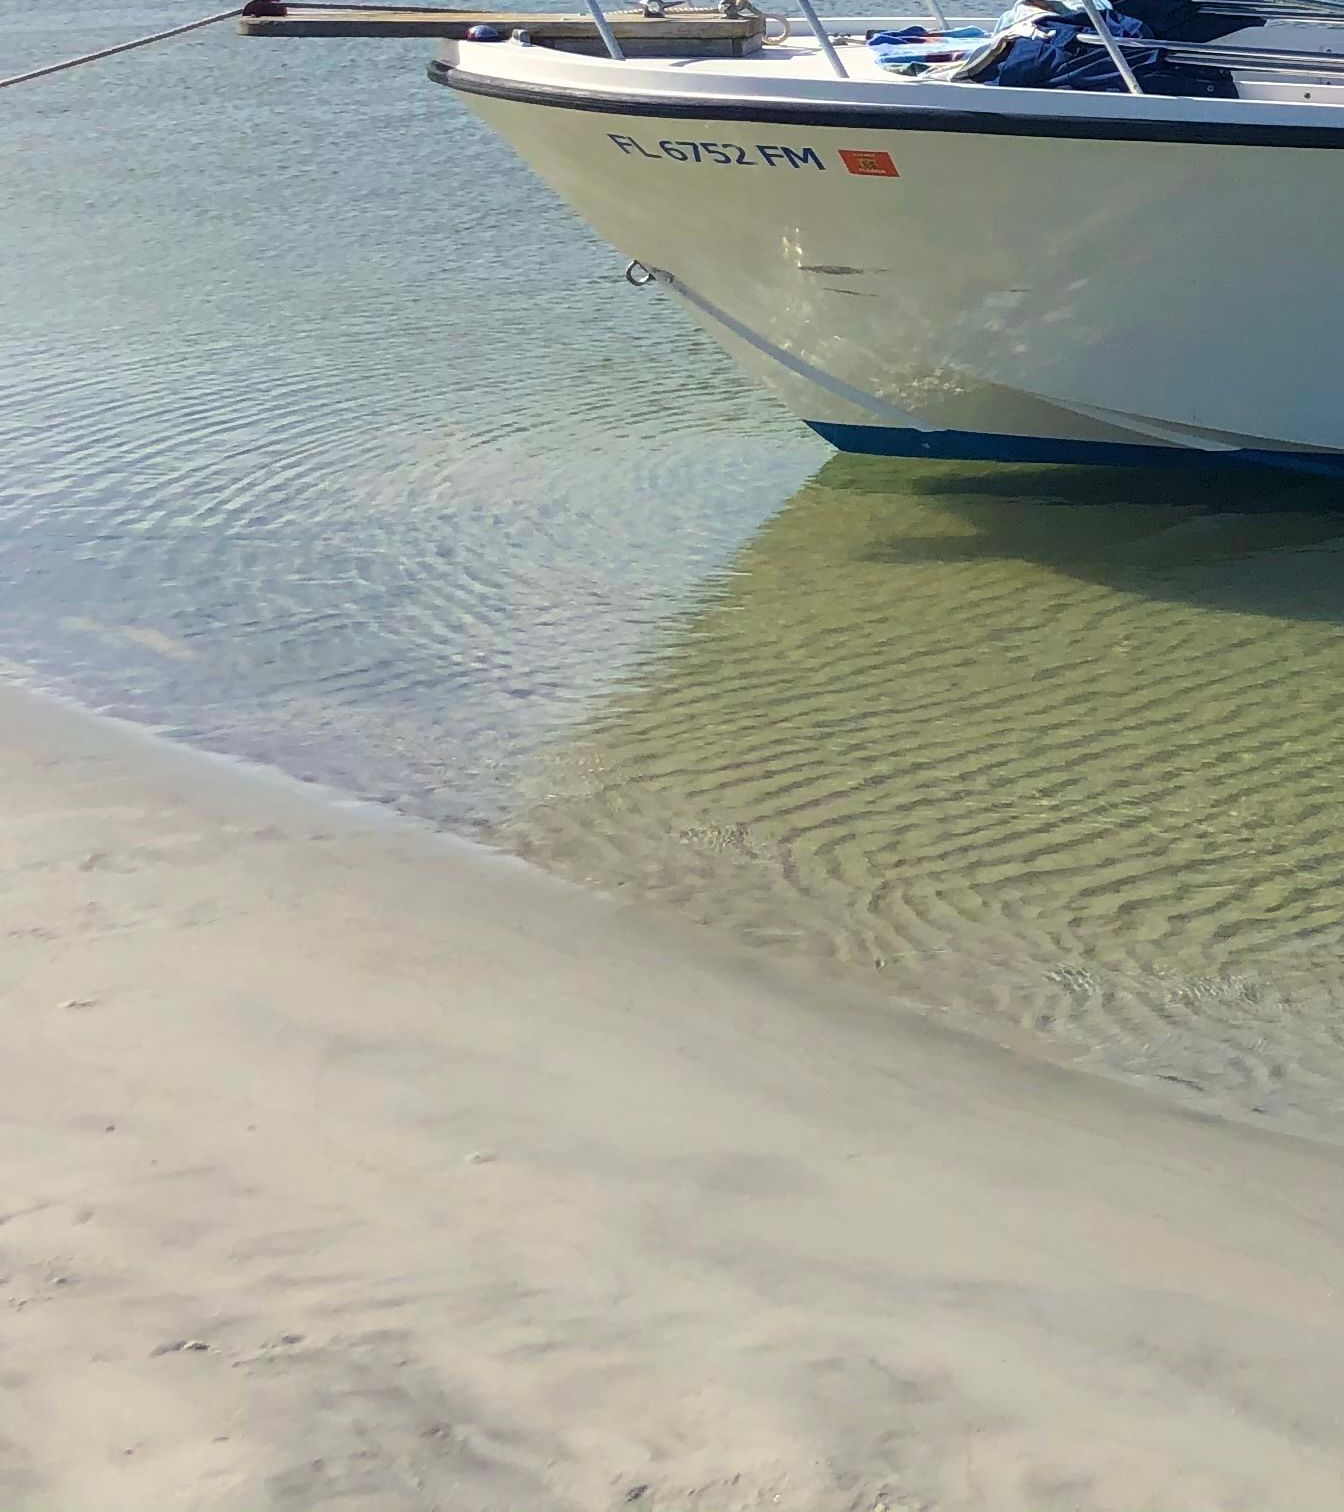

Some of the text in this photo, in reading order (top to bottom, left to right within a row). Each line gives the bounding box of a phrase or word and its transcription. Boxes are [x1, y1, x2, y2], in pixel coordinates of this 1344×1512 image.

[606, 133, 826, 170] FL 6752 FM
